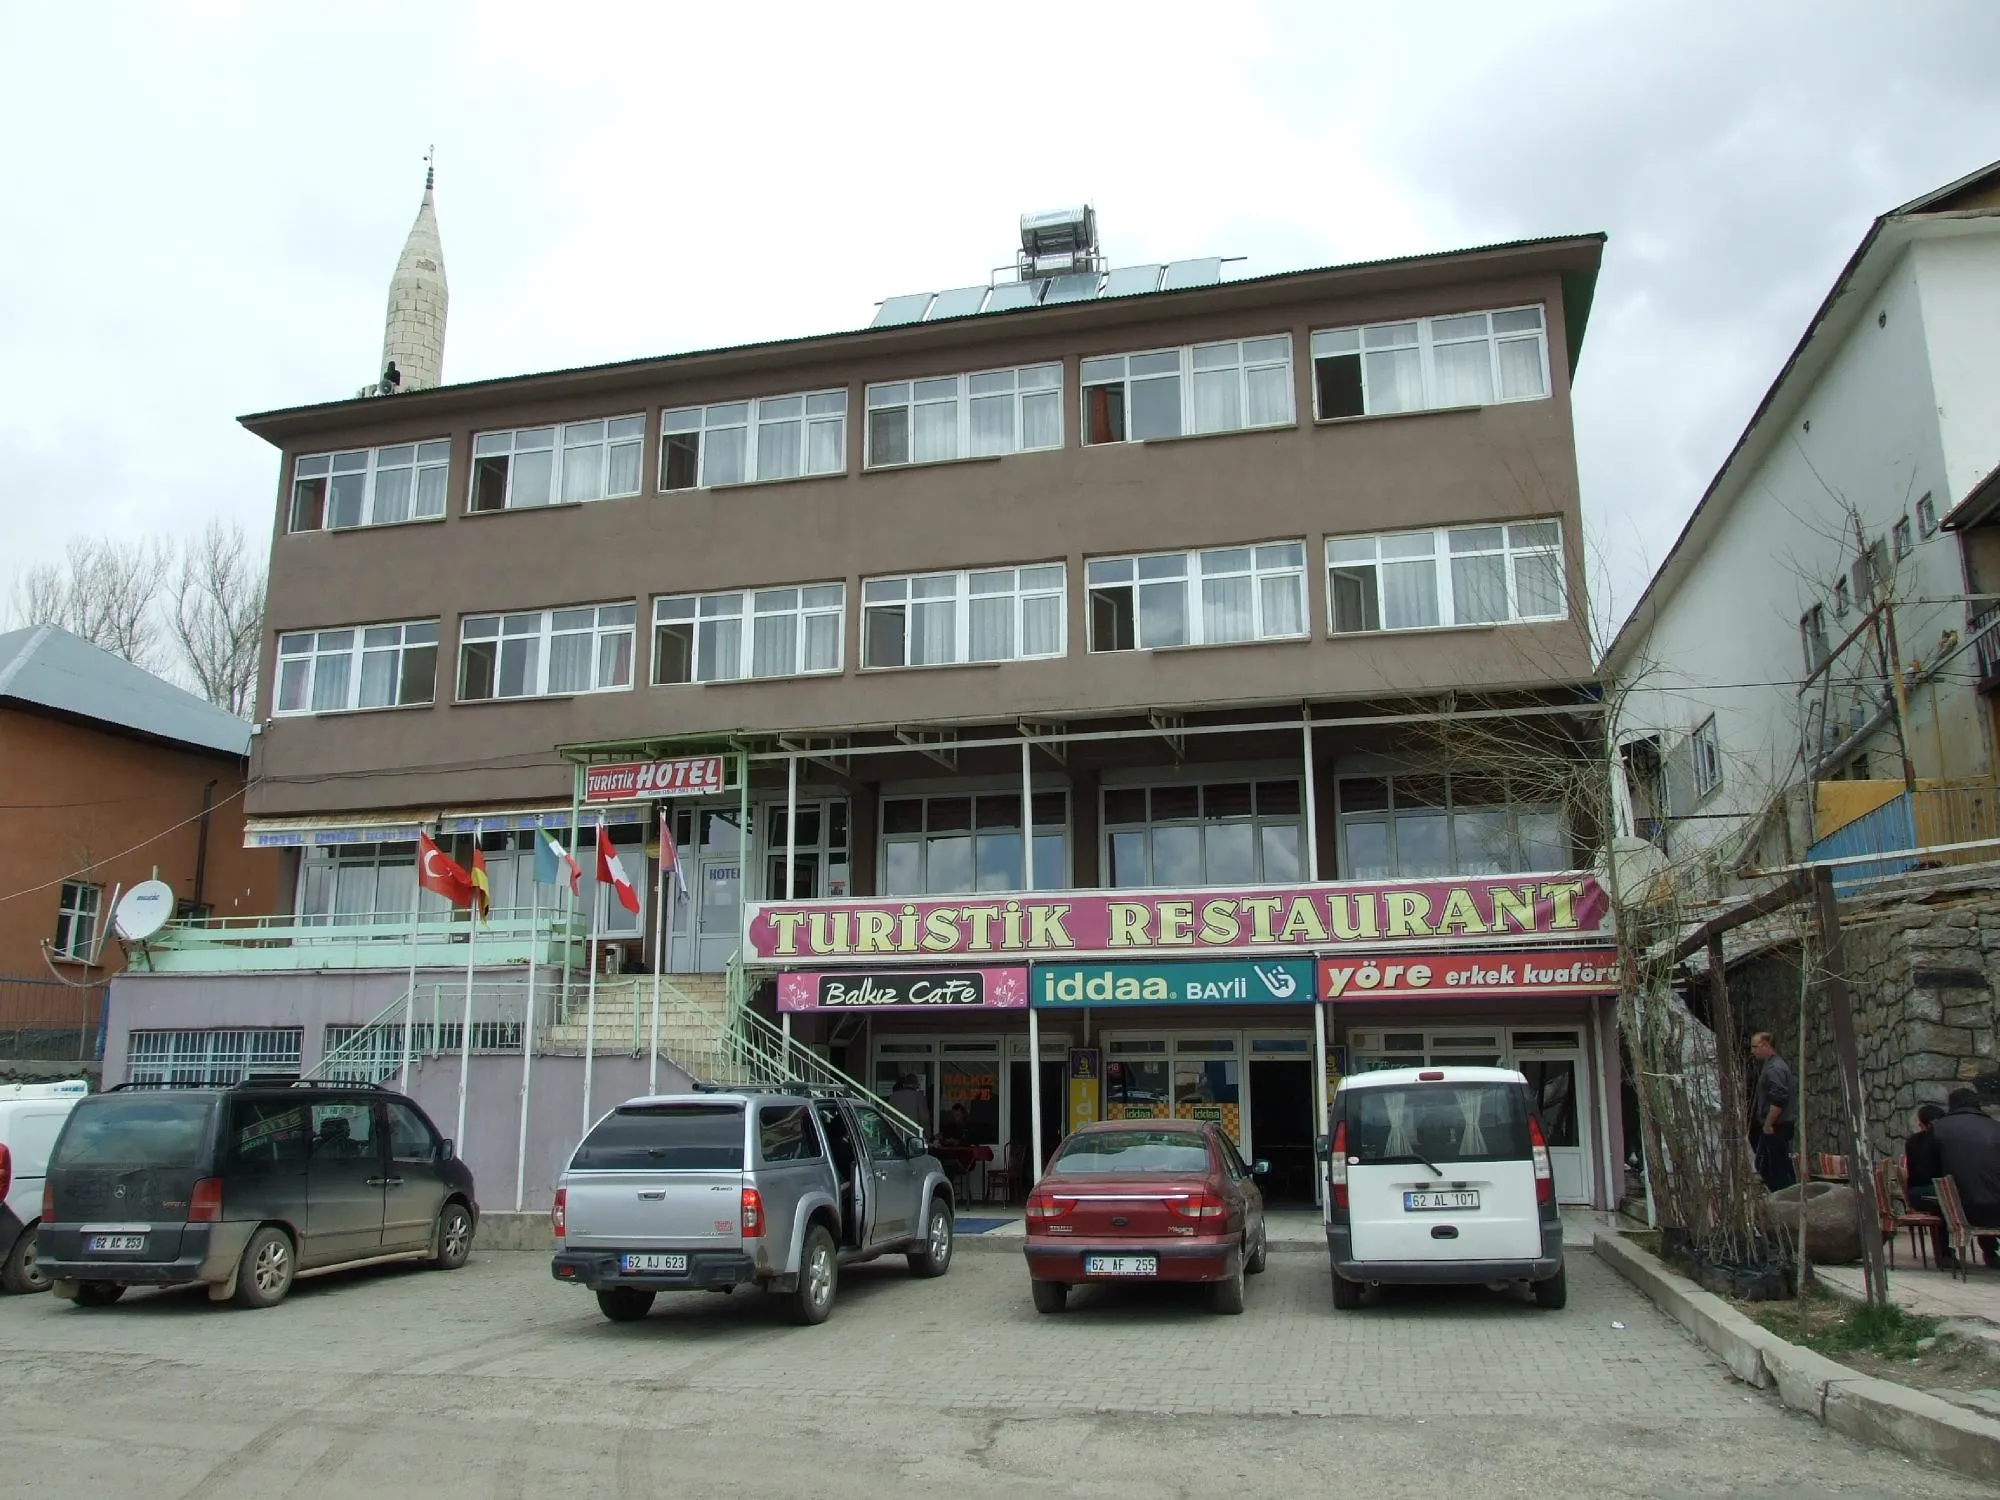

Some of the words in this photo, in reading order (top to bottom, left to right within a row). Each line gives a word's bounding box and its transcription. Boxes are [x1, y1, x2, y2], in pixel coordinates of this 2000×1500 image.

[588, 771, 634, 791] TURİSTİK
[635, 760, 718, 789] HOTEL
[768, 903, 1075, 955] TURİSTİK
[1106, 882, 1585, 949] RESTAURANT
[1327, 961, 1432, 997] yöre
[1445, 965, 1515, 986] erkek
[1045, 972, 1168, 1000] iddaa
[1194, 1109, 1220, 1120] iddaa
[1413, 1195, 1426, 1206] 62
[1434, 1194, 1448, 1205] AL
[96, 1238, 106, 1248] 62
[110, 1237, 121, 1248] AC
[125, 1236, 142, 1248] 253
[628, 1256, 641, 1268] 62
[647, 1256, 659, 1268] AJ
[665, 1255, 685, 1268] 623
[1092, 1259, 1104, 1271] 62
[1112, 1259, 1125, 1271] AF
[1135, 1259, 1155, 1271] 255
